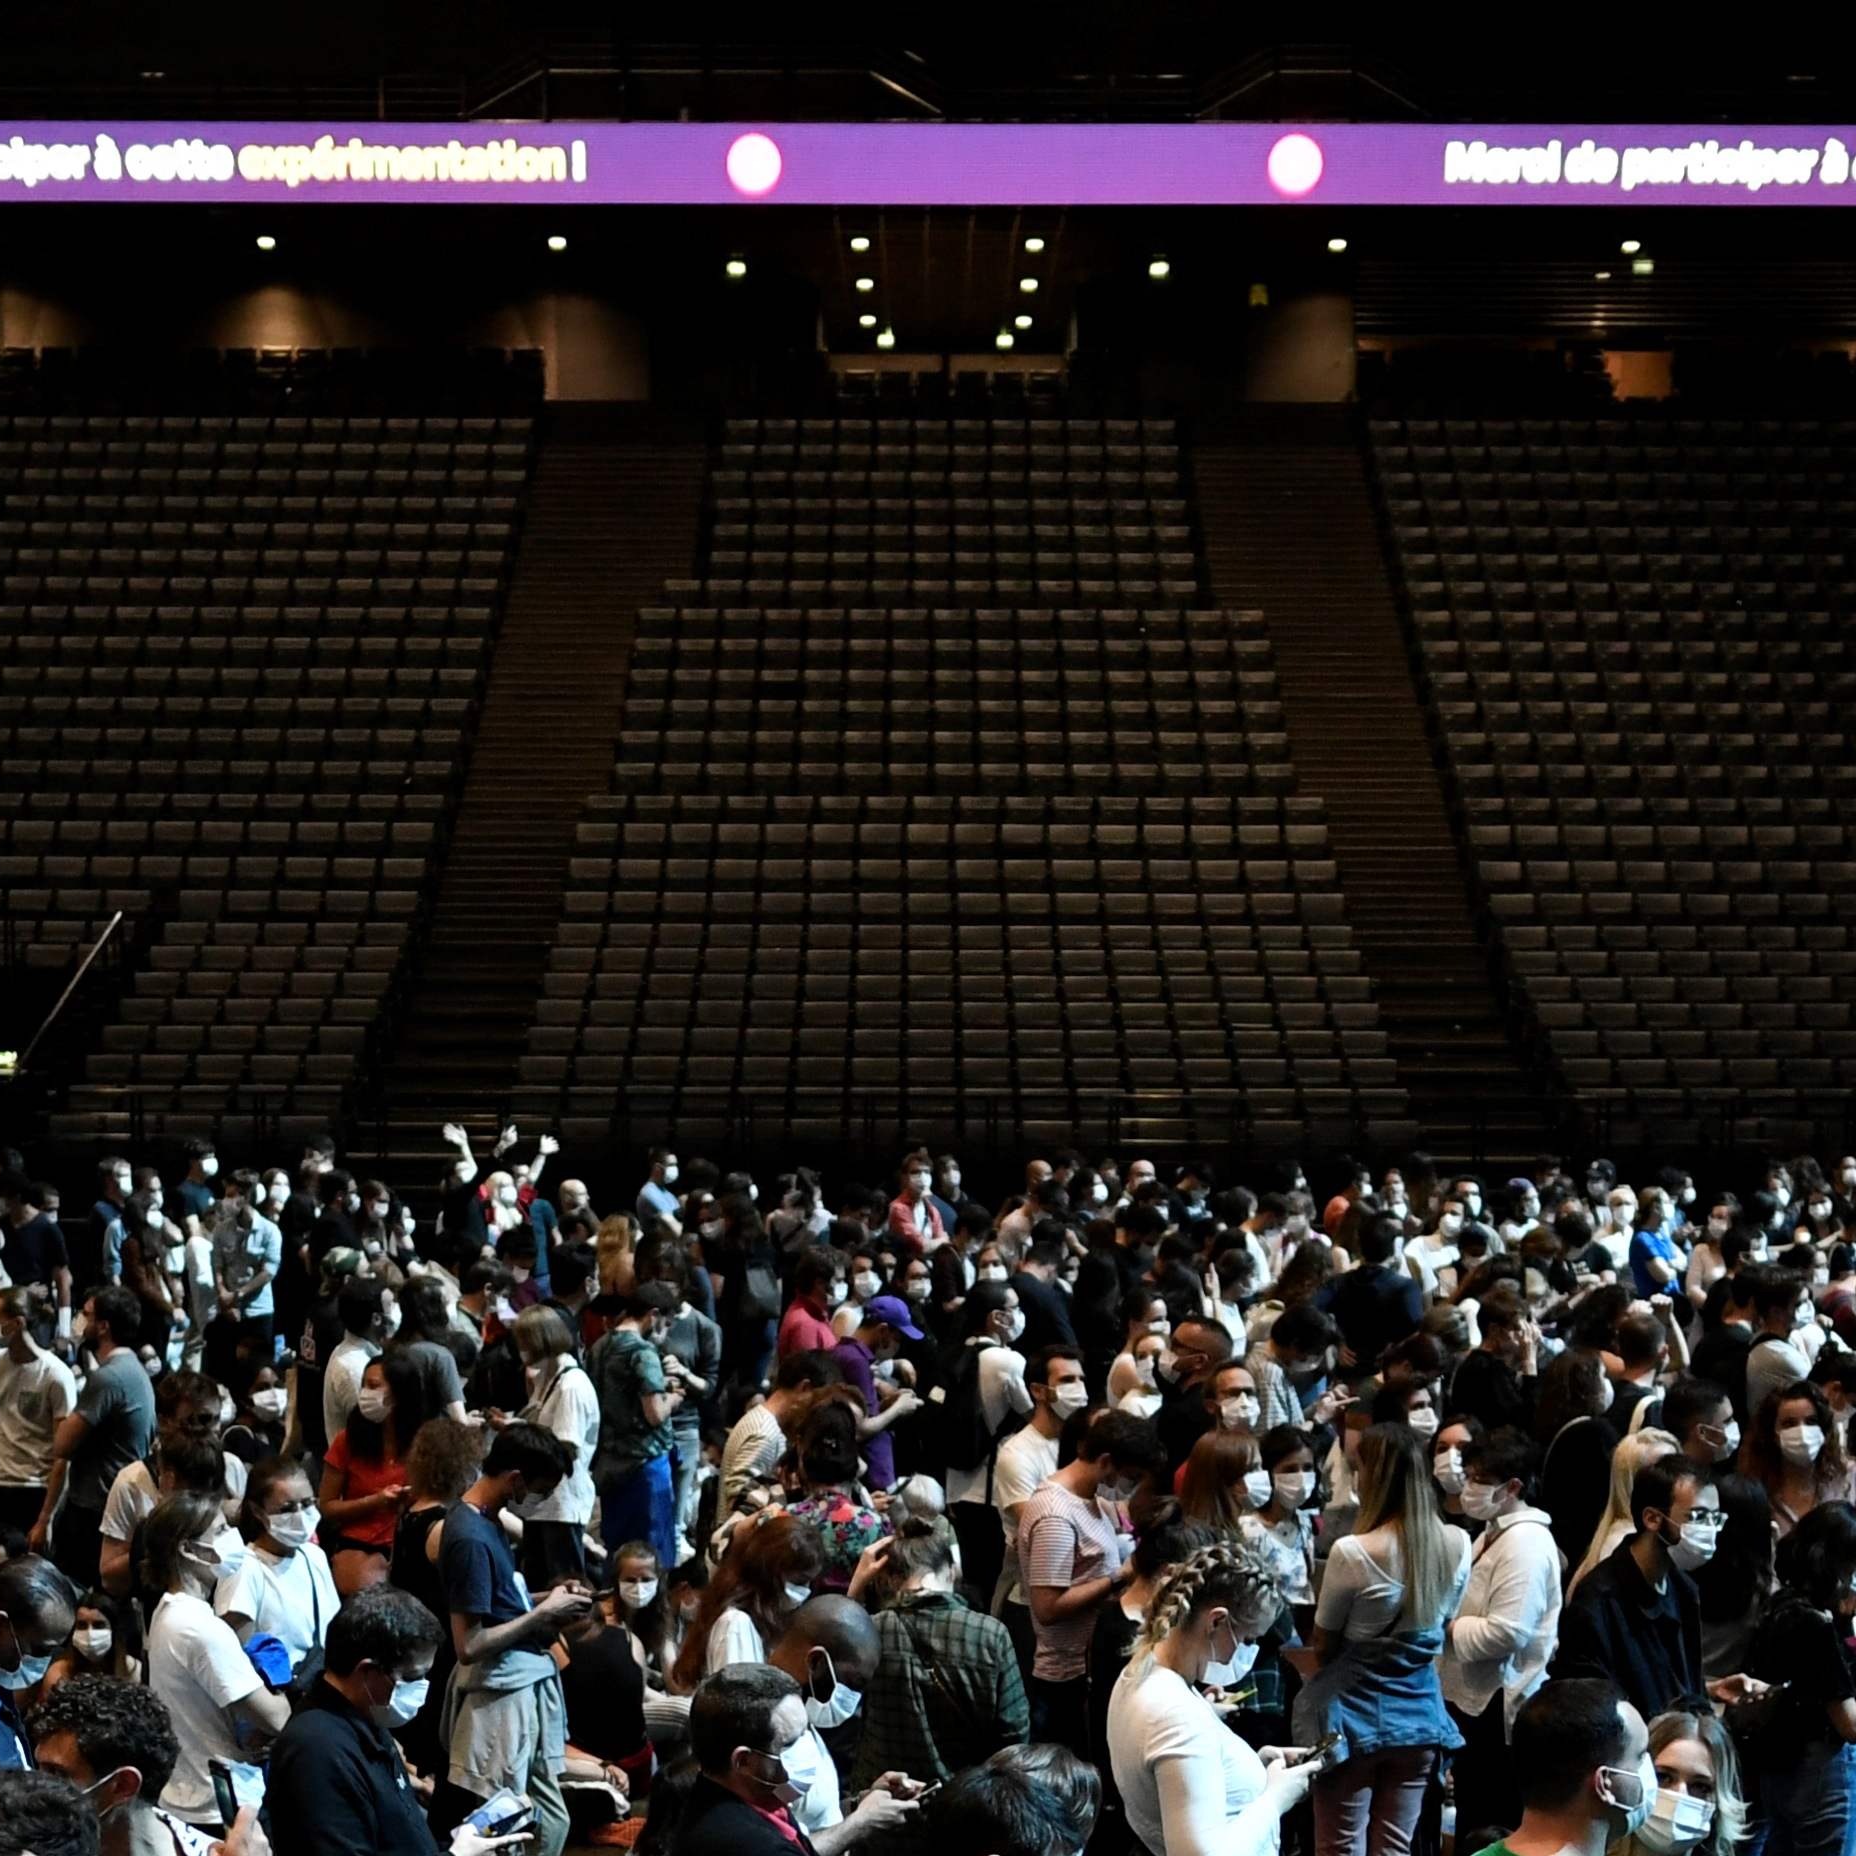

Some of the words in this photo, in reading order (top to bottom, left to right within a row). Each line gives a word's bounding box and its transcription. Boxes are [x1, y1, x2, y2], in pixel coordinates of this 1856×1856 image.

[92, 134, 123, 180] à
[124, 139, 236, 181] cette
[237, 135, 568, 187] expérimentation
[1444, 140, 1563, 184] Merci
[1563, 140, 1620, 184] de
[1620, 140, 1818, 191] participer
[1819, 138, 1850, 184] à
